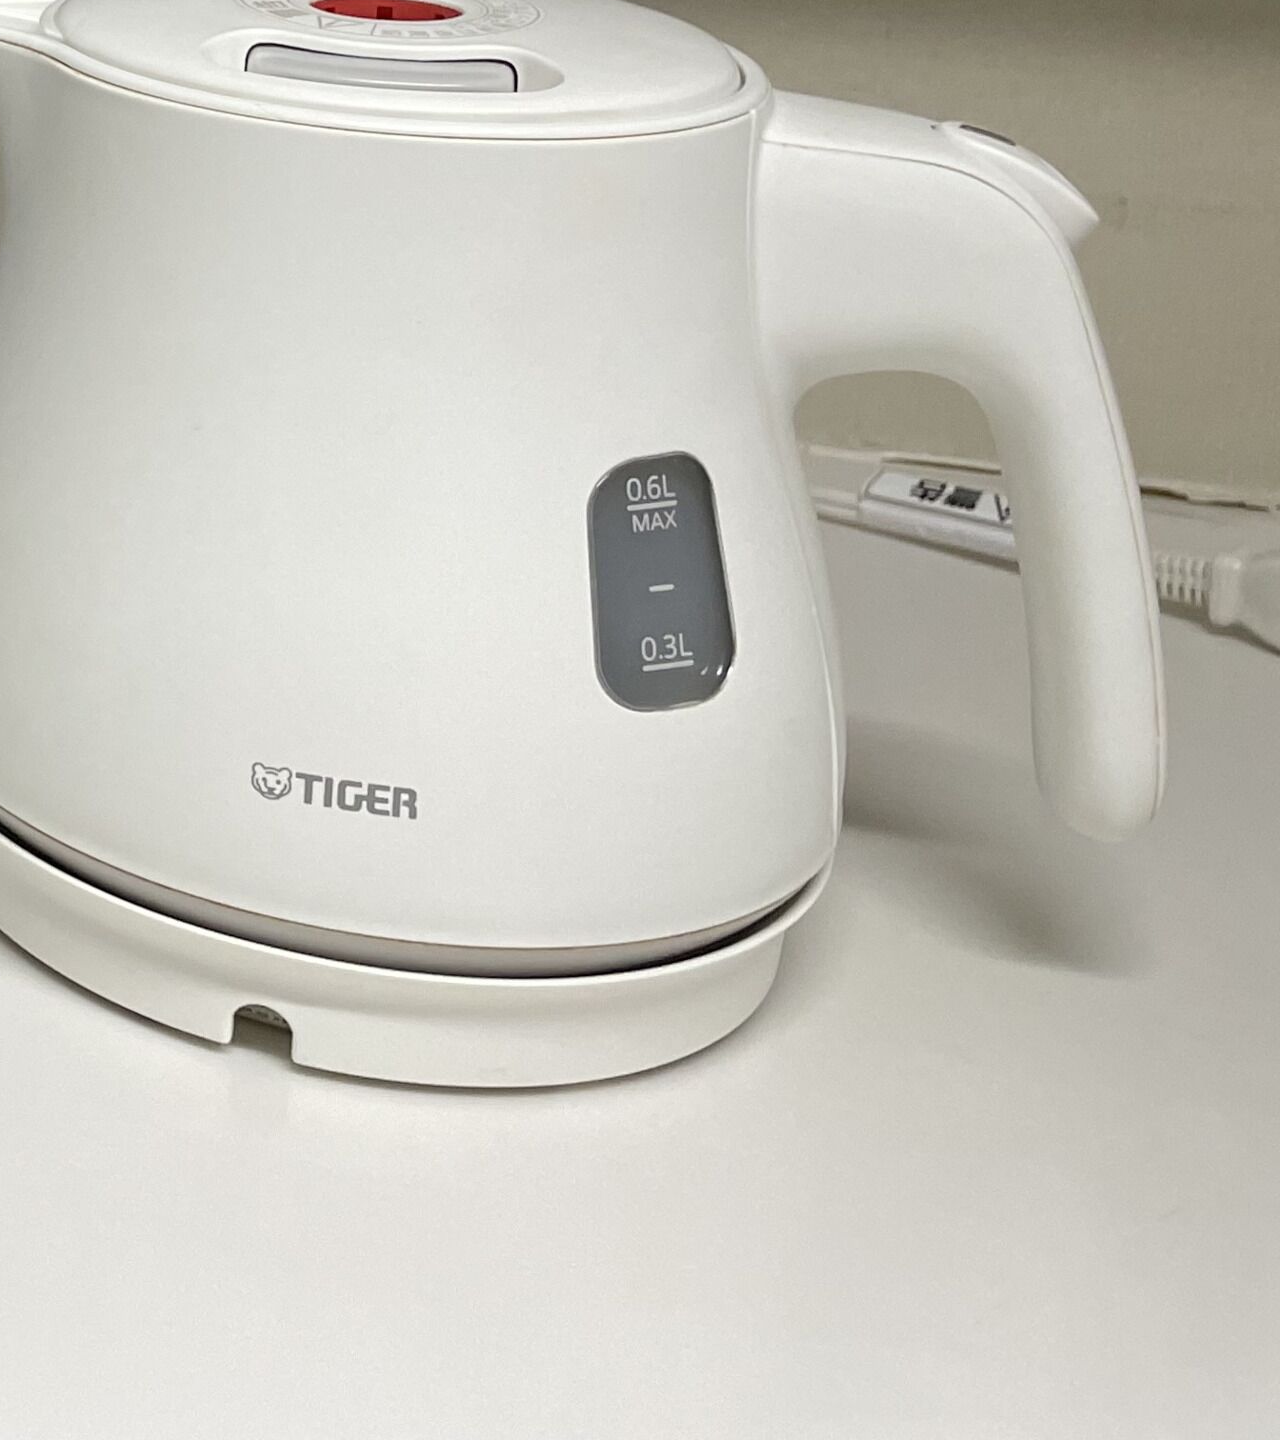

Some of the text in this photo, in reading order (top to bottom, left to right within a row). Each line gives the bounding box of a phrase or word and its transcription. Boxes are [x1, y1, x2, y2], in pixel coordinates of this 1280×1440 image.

[626, 474, 676, 501] 0.6L
[632, 510, 677, 533] MAX
[641, 633, 693, 661] 0.3L
[295, 772, 417, 819] TIGER
